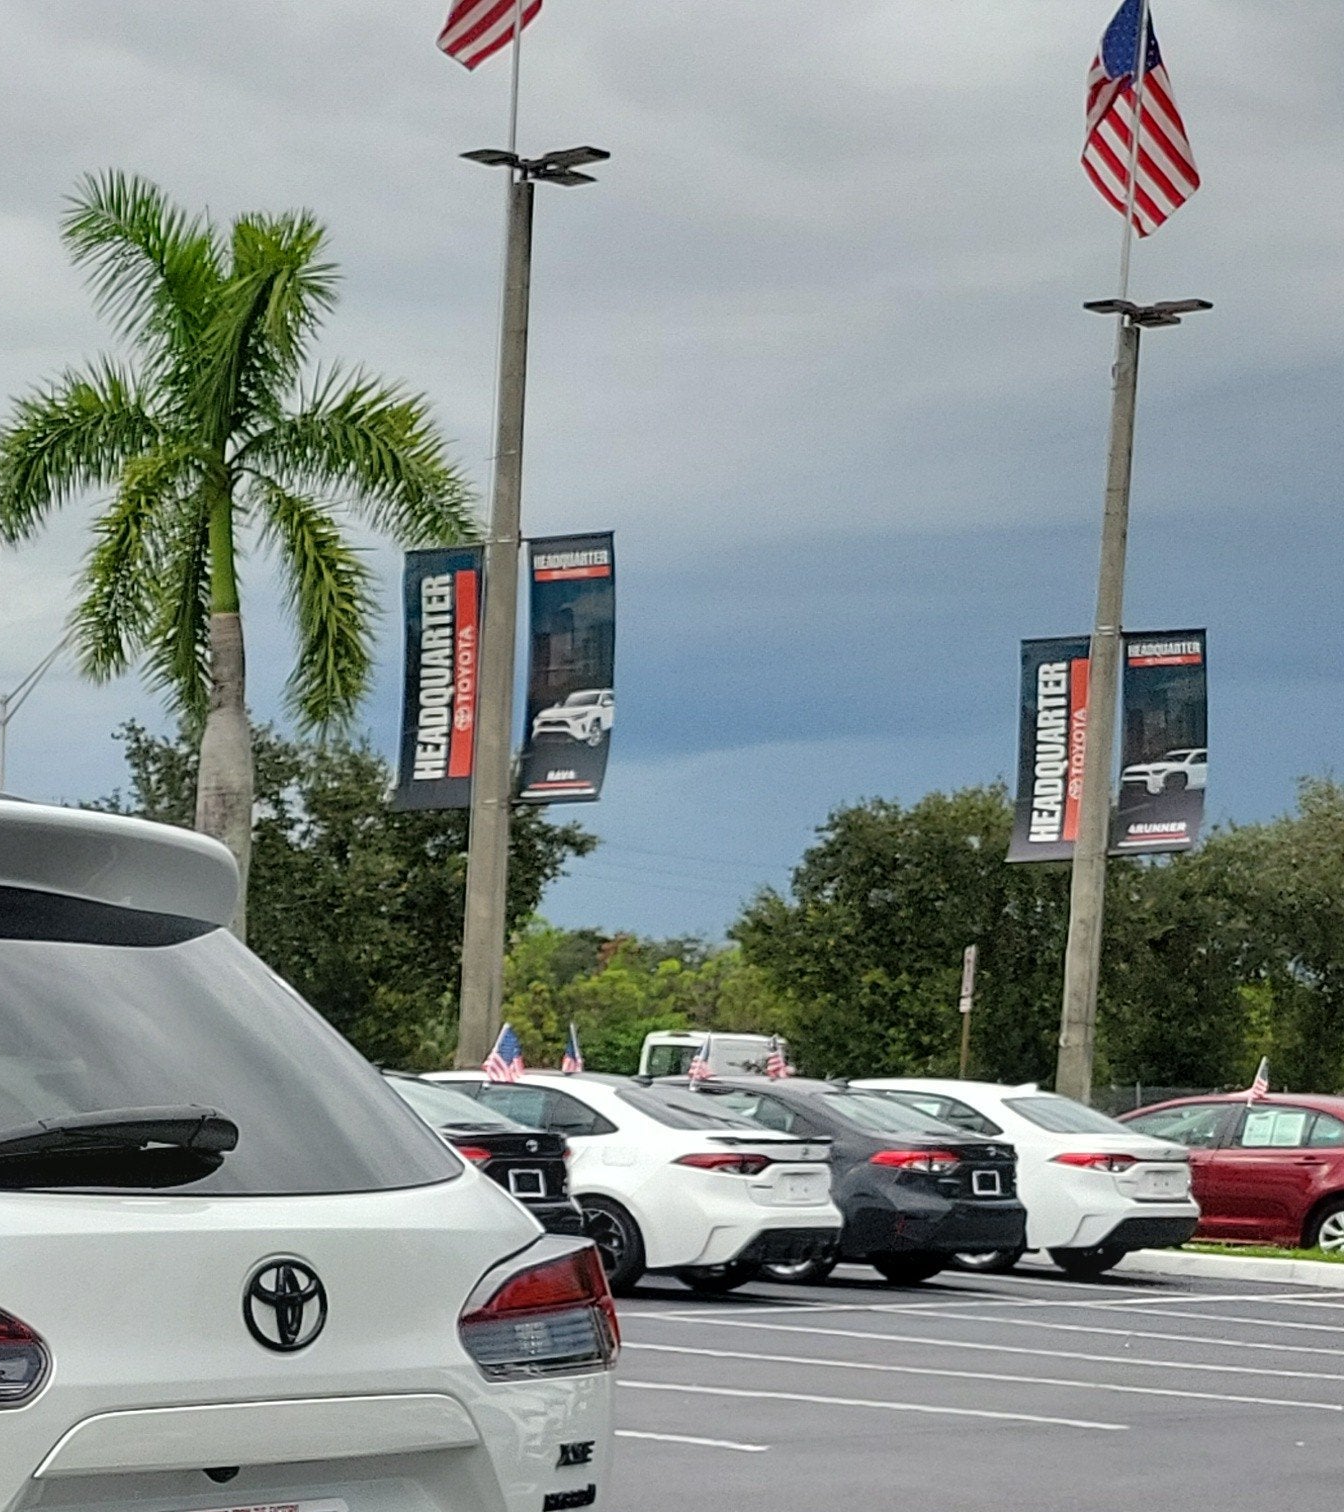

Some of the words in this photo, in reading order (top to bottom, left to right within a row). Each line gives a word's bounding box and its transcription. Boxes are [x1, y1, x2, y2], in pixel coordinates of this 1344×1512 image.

[413, 571, 455, 782] HEADQUARTER
[457, 625, 476, 706] TOYOTA
[1029, 661, 1069, 843] HEADQUARTER
